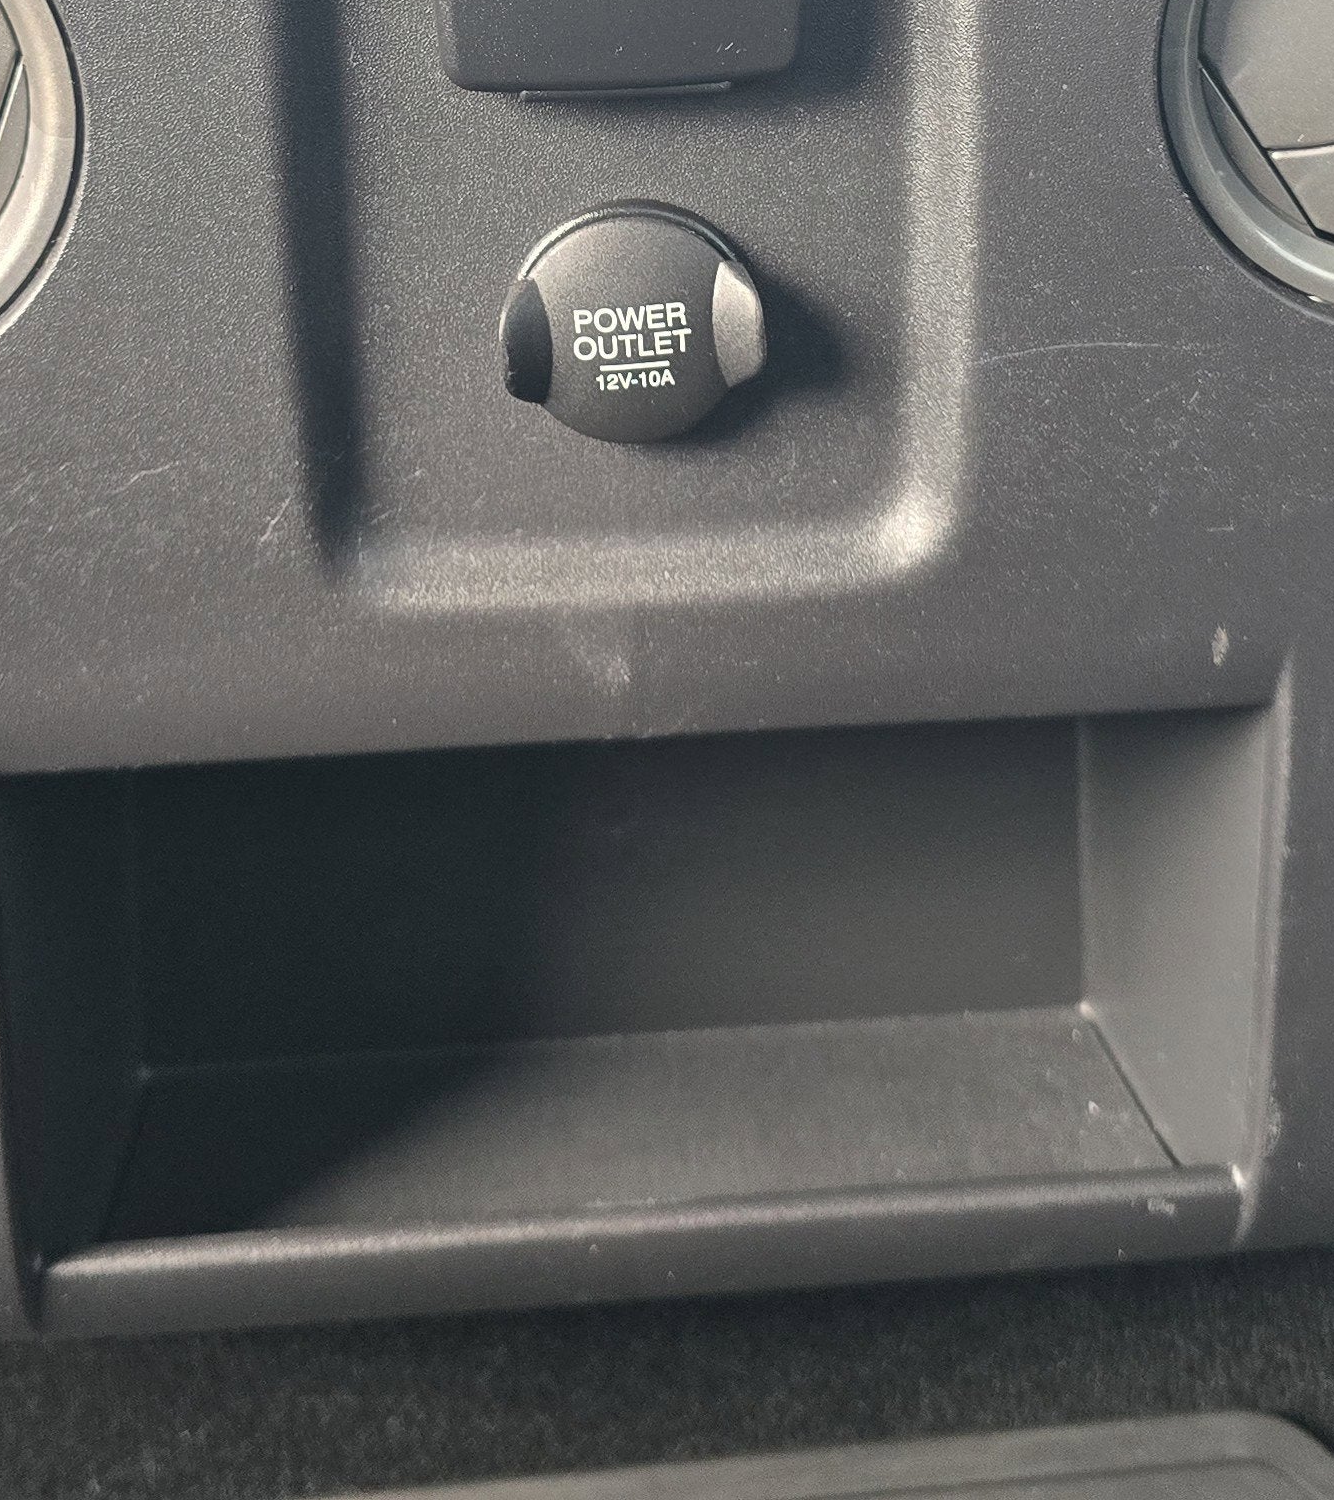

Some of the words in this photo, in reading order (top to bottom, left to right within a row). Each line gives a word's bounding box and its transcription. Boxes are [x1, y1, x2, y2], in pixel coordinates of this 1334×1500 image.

[572, 301, 688, 335] POWER
[572, 327, 693, 362] OUTLET
[595, 368, 676, 392] 12V-10A
